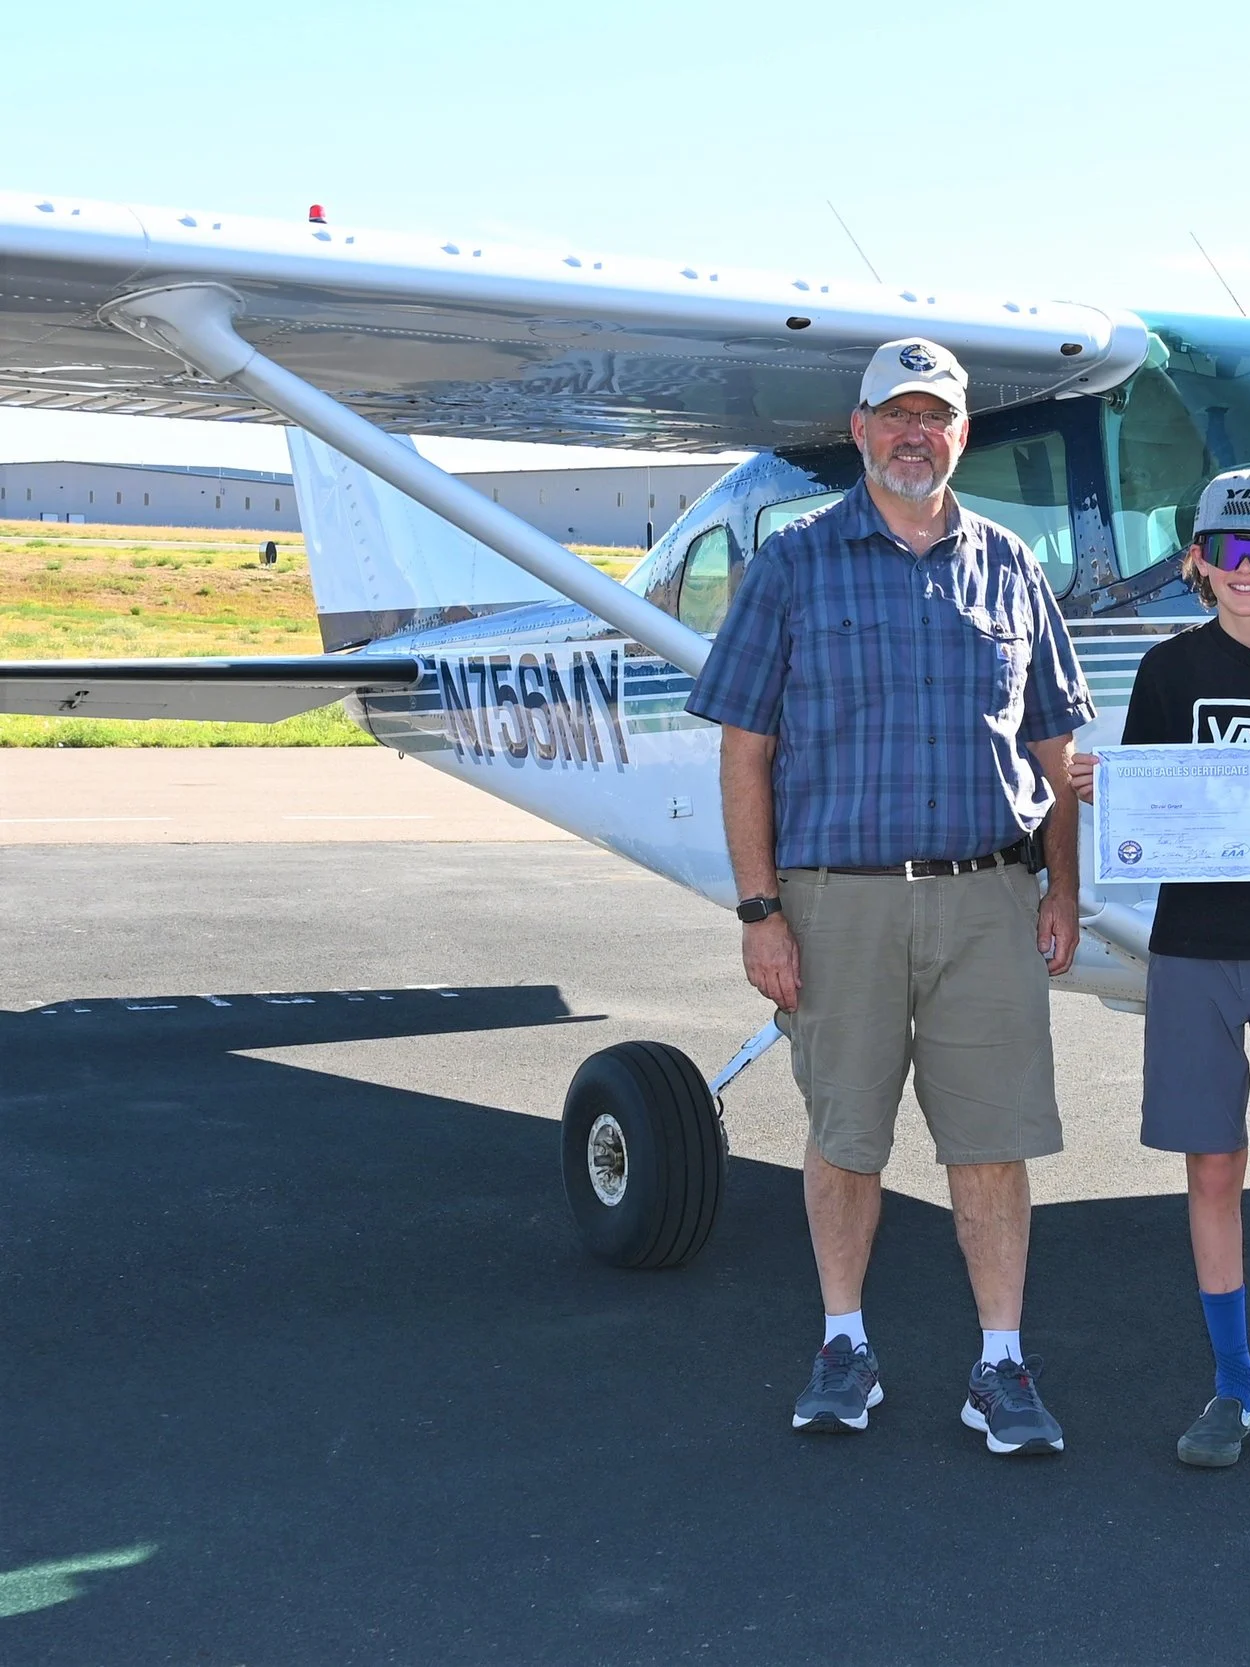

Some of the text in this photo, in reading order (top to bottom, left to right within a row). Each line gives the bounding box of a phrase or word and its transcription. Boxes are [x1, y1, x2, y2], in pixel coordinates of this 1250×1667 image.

[437, 649, 629, 768] N756MY
[1117, 765, 1249, 778] YOUNG EAGLES CERTIFICATE
[1221, 849, 1245, 857] EAA
